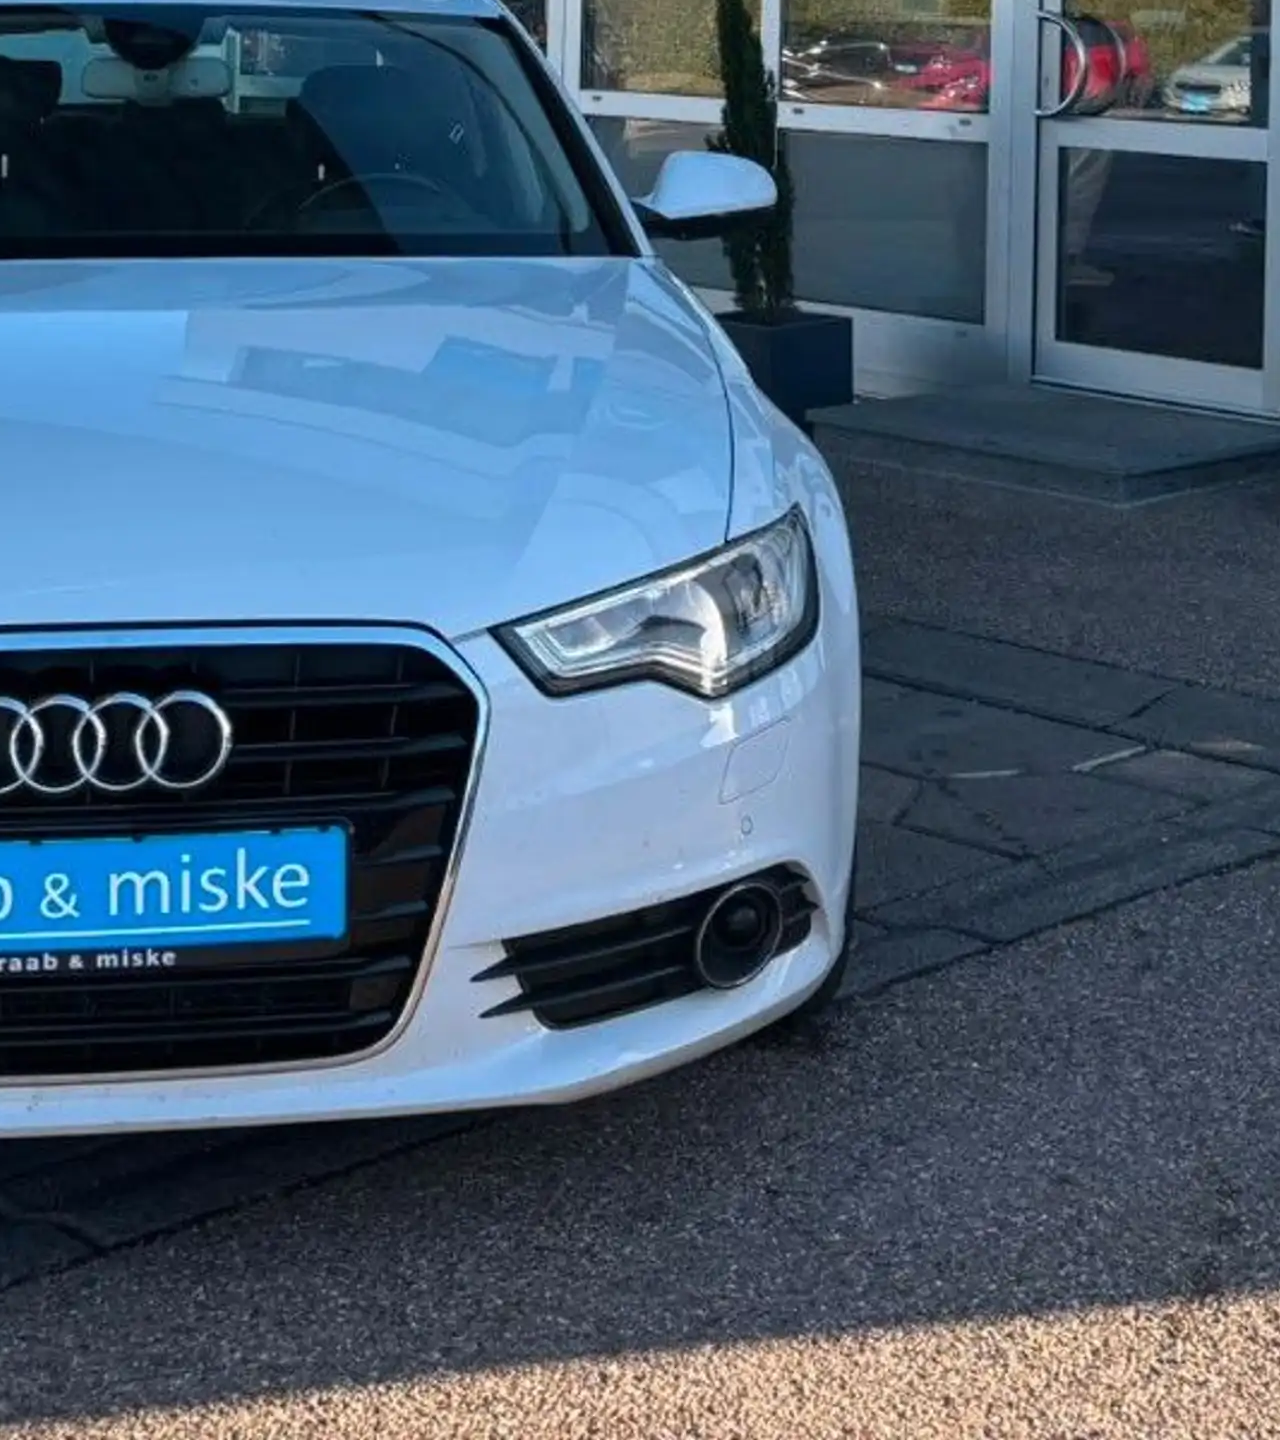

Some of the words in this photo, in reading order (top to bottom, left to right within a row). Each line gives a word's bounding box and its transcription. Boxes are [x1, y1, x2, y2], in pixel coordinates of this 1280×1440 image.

[39, 872, 81, 919] &
[109, 849, 312, 916] miske
[69, 954, 84, 970] &
[96, 947, 177, 969] miske
